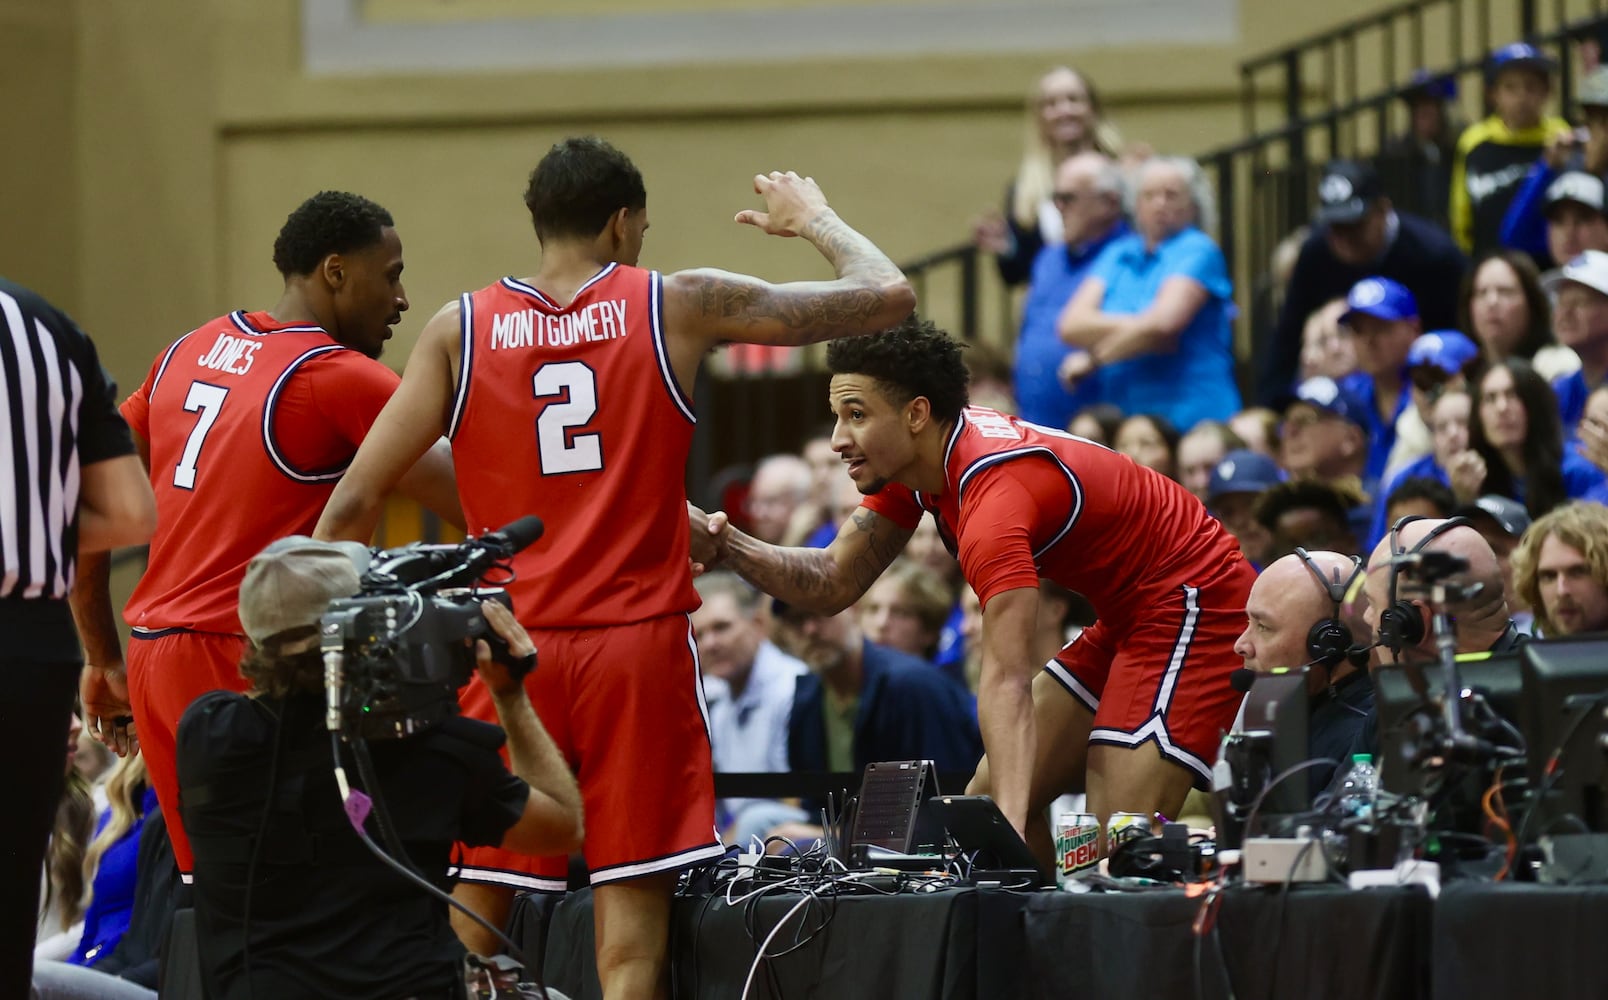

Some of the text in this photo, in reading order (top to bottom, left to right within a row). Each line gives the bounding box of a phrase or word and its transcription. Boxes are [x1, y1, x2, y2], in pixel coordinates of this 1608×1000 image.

[490, 299, 627, 350] MONTGOMERY
[197, 332, 263, 376] JONES
[173, 379, 231, 491] 7
[531, 360, 604, 476] 2
[1064, 826, 1082, 838] DIET
